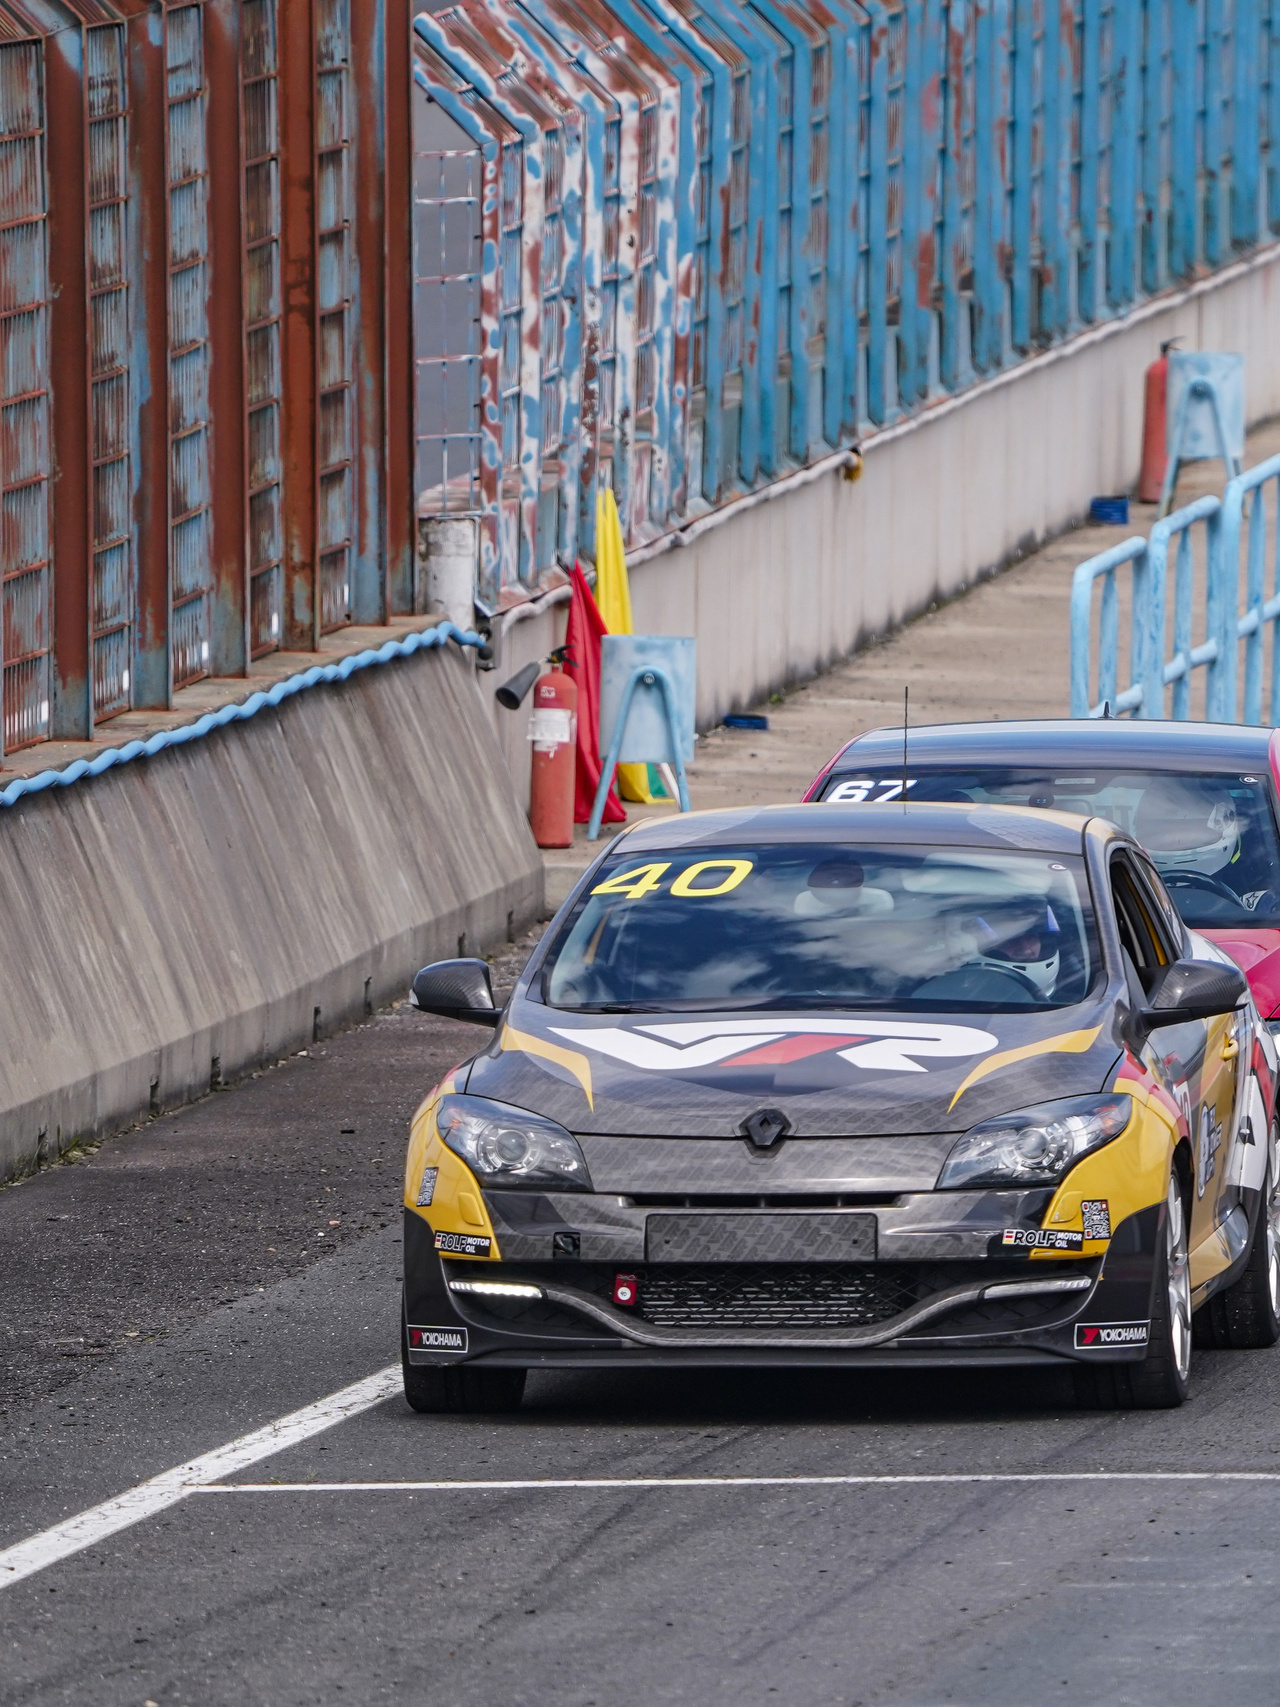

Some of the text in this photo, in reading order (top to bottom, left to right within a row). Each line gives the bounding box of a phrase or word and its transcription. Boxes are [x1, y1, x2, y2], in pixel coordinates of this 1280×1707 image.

[826, 780, 918, 802] 67
[590, 859, 754, 899] 40
[440, 1233, 490, 1251] ROLF MOTOR
[1013, 1229, 1082, 1246] ROLF MOTOR
[1054, 1240, 1068, 1248] OIL
[465, 1245, 475, 1253] OIL
[421, 1332, 462, 1347] YOKOHAMA
[1099, 1327, 1147, 1342] YOKOHAMA
